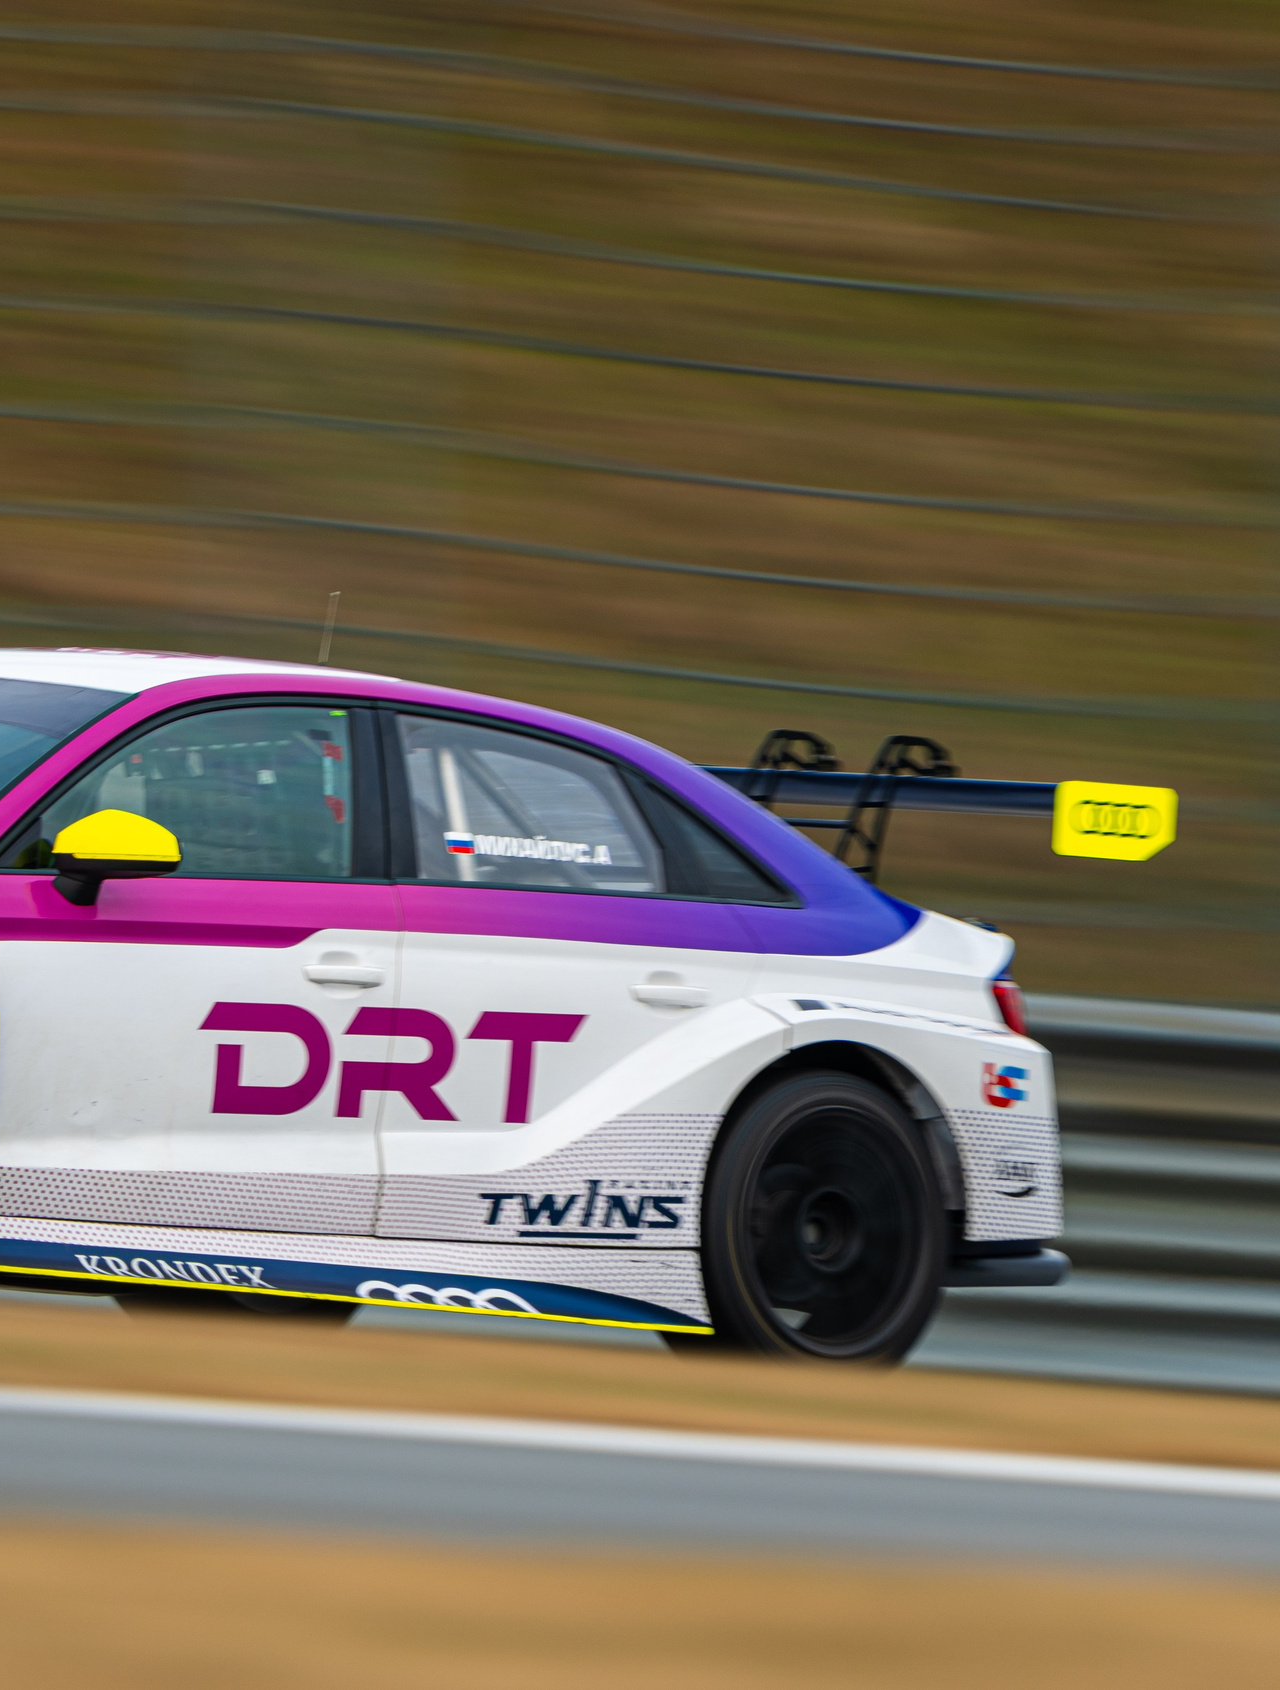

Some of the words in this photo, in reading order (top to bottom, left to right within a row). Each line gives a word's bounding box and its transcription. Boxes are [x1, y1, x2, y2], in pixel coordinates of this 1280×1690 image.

[197, 1001, 590, 1124] DRT
[479, 1179, 685, 1229] TWINS
[74, 1254, 278, 1290] KRONDEX
